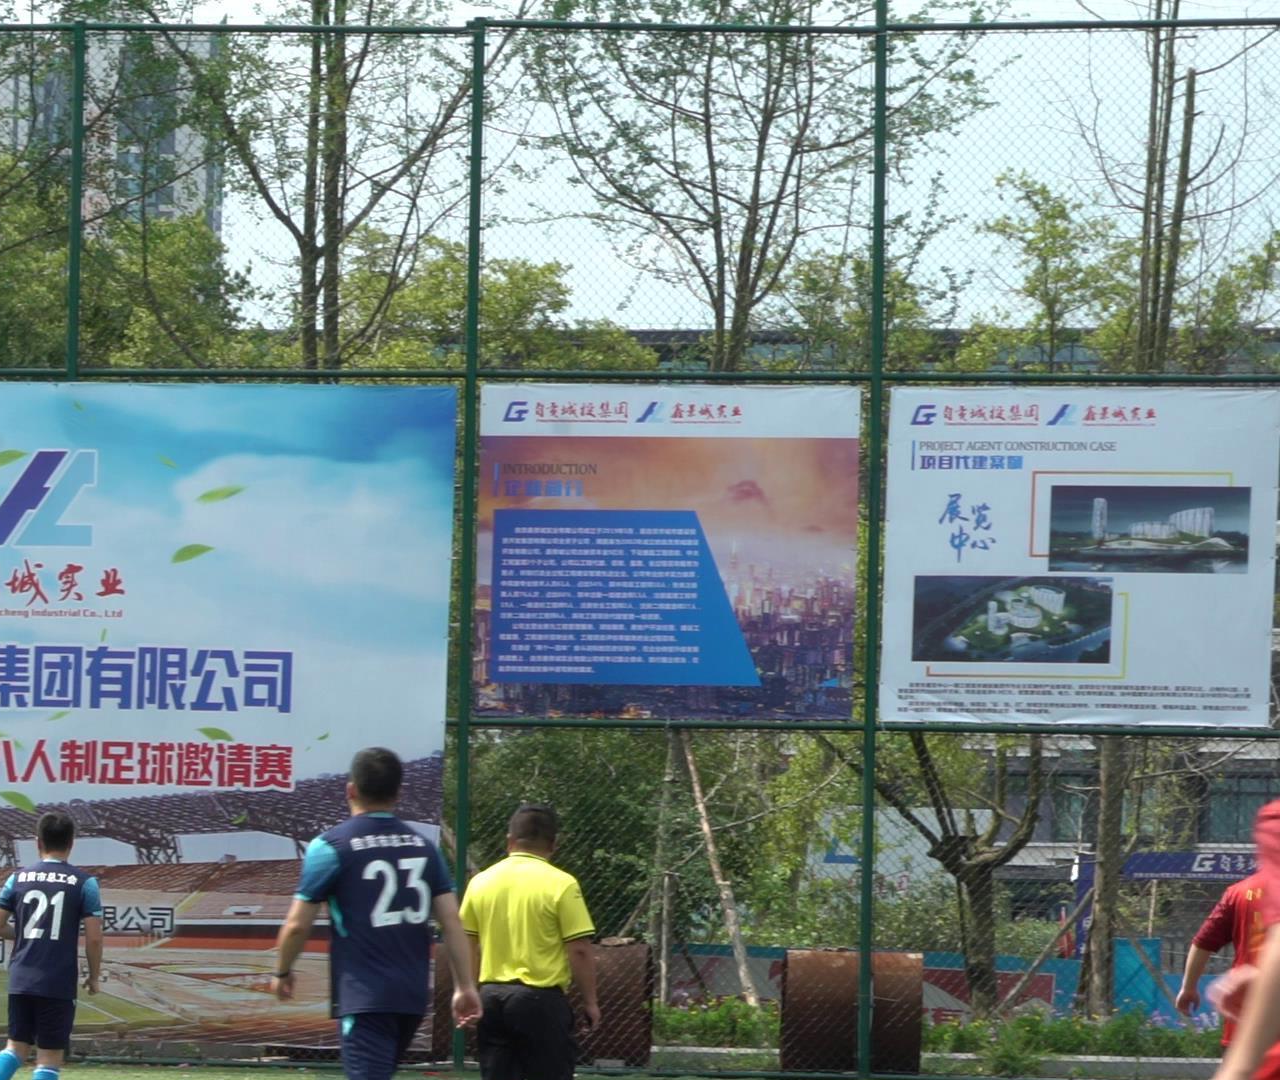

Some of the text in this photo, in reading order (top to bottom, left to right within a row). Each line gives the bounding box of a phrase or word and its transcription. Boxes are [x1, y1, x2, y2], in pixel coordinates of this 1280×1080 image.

[919, 441, 1117, 452] PROJECT AGENT CONSTRUCTION CASE
[503, 463, 598, 475] INTRODUCTION
[31, 608, 81, 618] Industrial
[362, 856, 432, 928] 23
[23, 889, 66, 940] 21
